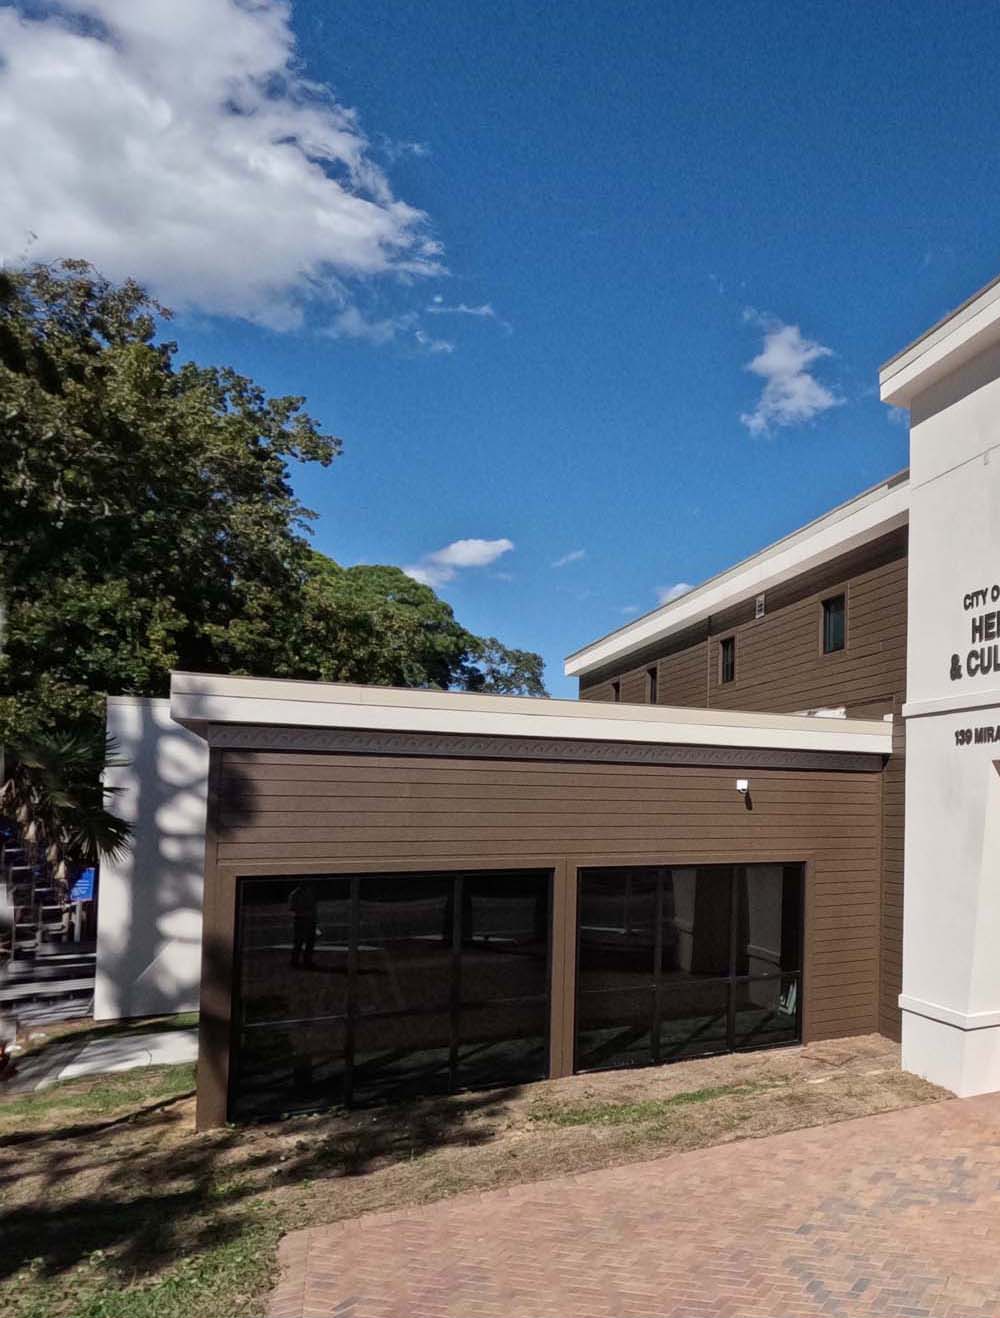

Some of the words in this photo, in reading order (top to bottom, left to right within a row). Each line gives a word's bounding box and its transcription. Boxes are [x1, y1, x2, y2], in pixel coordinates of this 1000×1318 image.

[963, 587, 988, 610] CITY
[950, 654, 962, 680] &
[955, 727, 972, 745] 139
